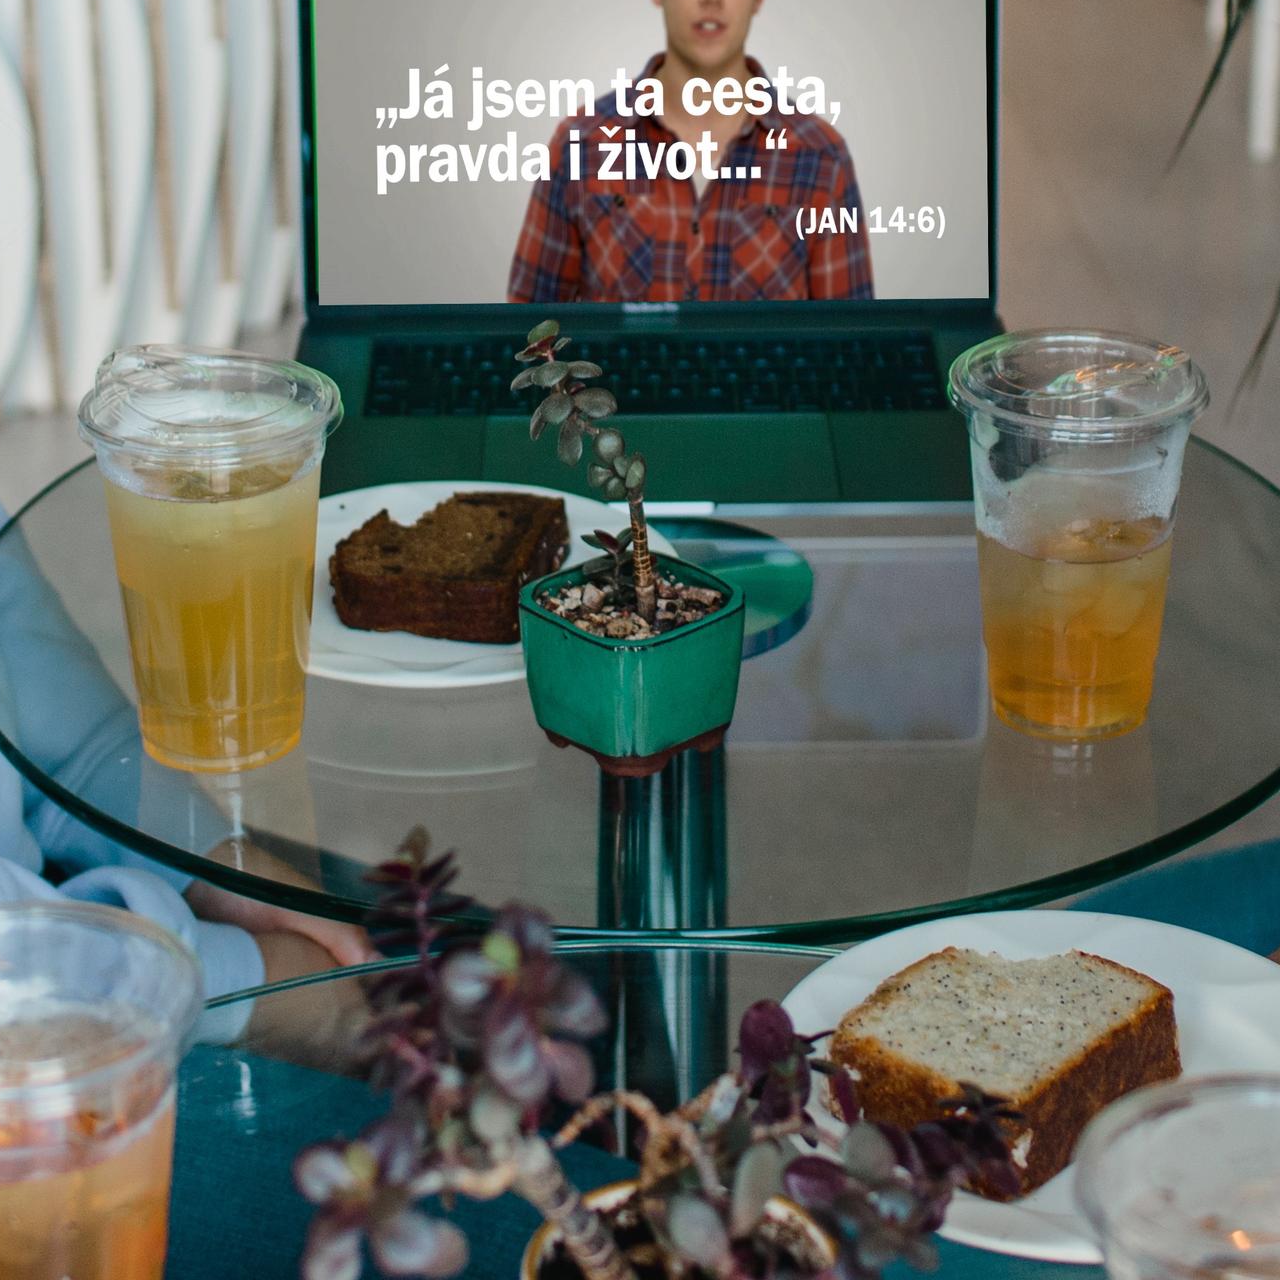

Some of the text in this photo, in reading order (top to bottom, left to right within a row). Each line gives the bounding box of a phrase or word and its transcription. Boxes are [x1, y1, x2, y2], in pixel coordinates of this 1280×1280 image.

[467, 66, 596, 131] jsem
[610, 67, 664, 117] ta
[682, 65, 841, 125] cesta,
[376, 131, 551, 195] pravda
[569, 129, 580, 180] i
[795, 206, 946, 240] (JAN 14:6)
